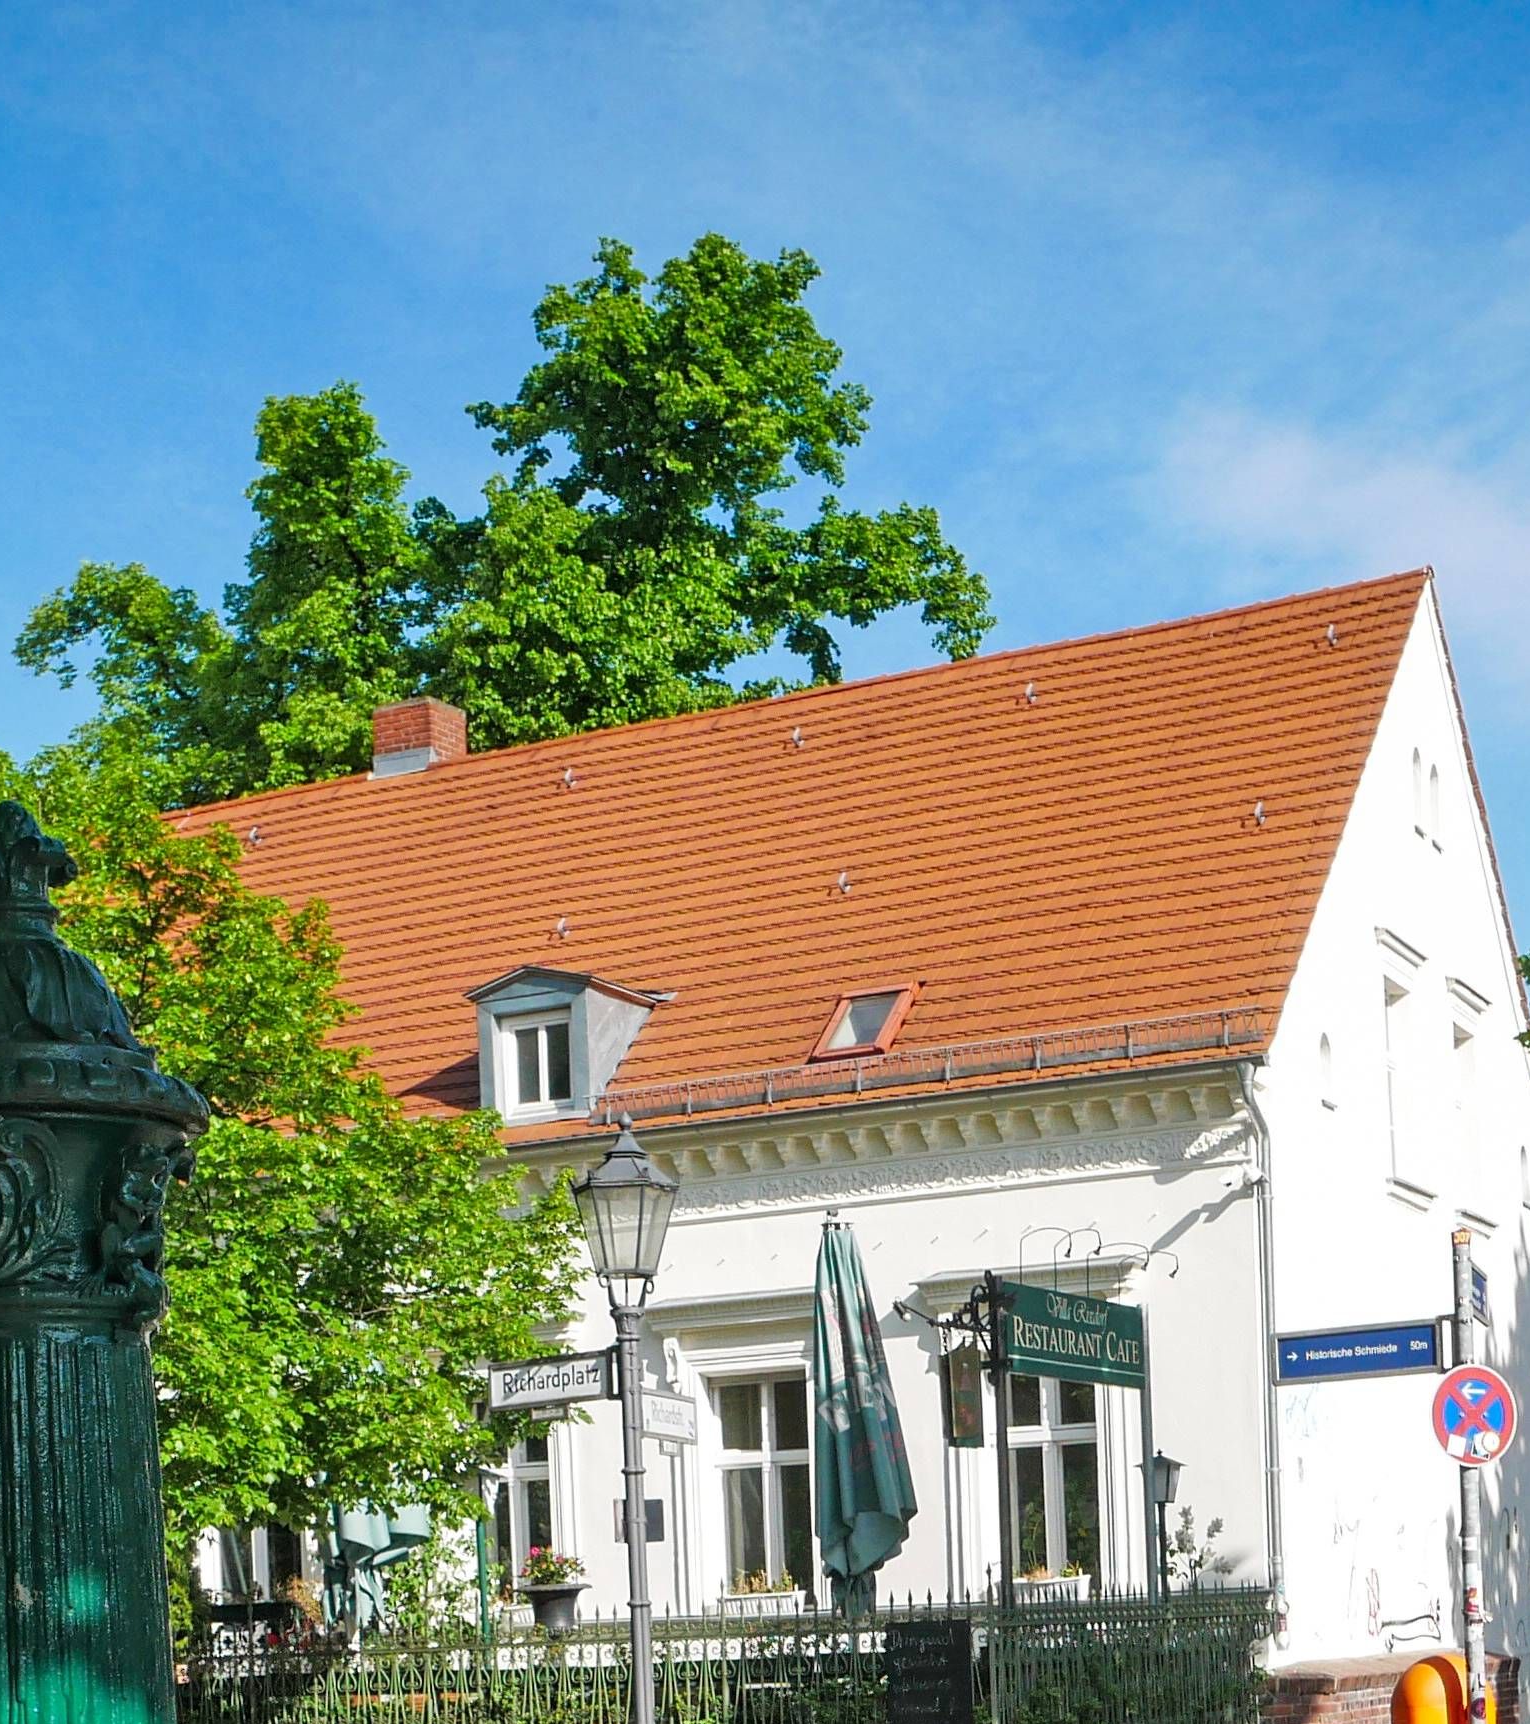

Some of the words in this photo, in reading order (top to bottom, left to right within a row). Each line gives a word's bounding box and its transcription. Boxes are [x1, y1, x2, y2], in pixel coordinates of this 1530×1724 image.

[1013, 1315, 1103, 1359] RESTAURANT
[1106, 1331, 1140, 1365] CAFE
[1305, 1347, 1353, 1361] Historische
[1354, 1343, 1398, 1357] Schmiede
[1409, 1340, 1429, 1351] 50m
[502, 1364, 600, 1394] Richardplatz
